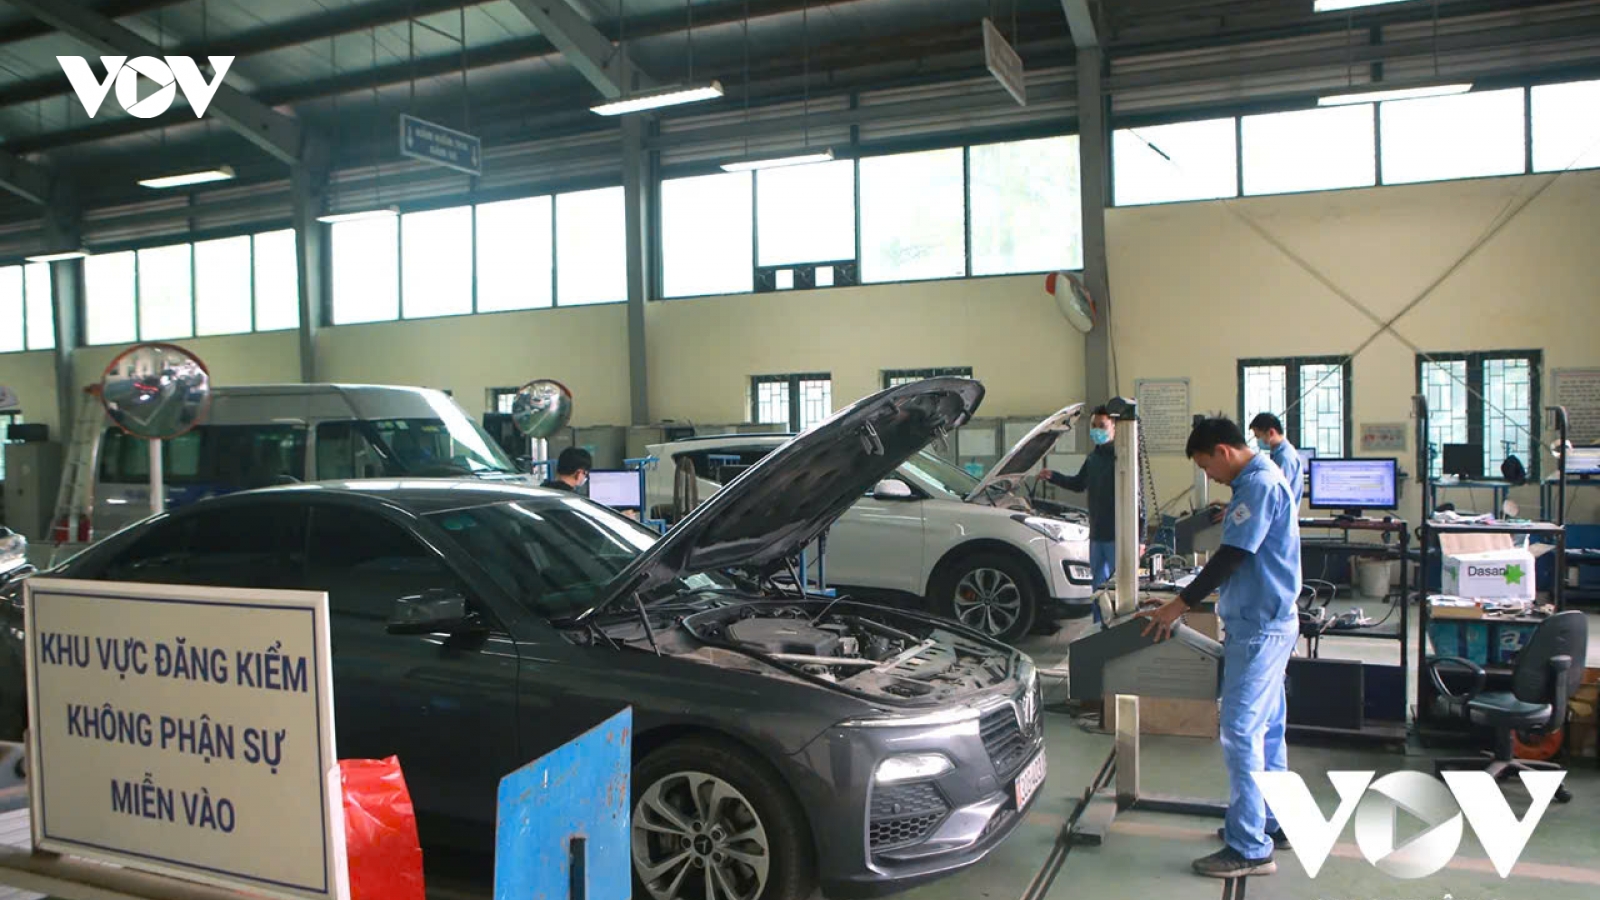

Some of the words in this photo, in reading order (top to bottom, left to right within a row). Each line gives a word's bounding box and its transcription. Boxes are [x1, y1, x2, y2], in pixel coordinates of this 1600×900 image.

[41, 632, 90, 668] KHU
[96, 637, 148, 680] VỰC
[155, 636, 228, 684] ĐĂNG
[236, 640, 308, 693] KIỂM
[67, 702, 153, 747] KHÔNG
[160, 713, 235, 764] PHẬN
[243, 728, 286, 775] SỰ
[111, 772, 175, 823] MIỄN
[181, 787, 236, 833] VÀO
